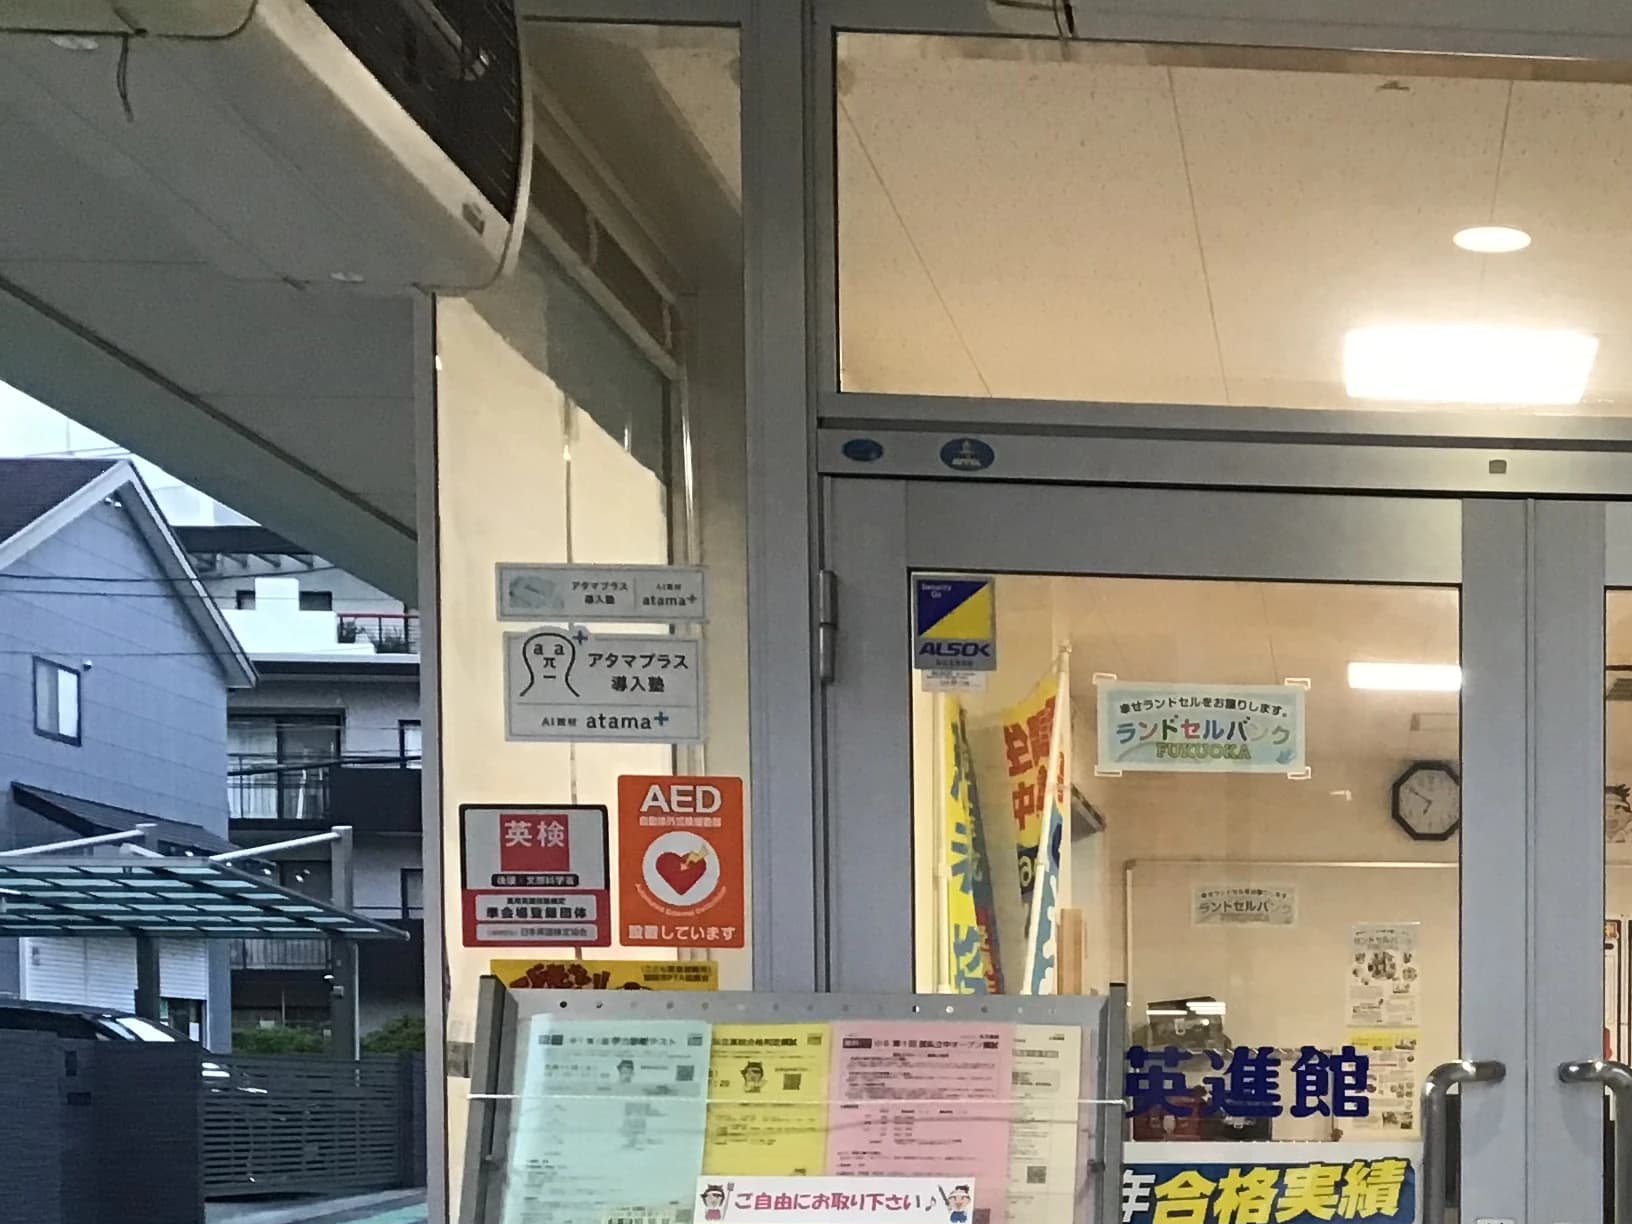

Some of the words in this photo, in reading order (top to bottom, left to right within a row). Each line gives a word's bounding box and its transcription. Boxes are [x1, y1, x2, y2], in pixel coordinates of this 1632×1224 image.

[571, 581, 628, 591] アタマプラス
[642, 594, 697, 606] atama+
[919, 642, 991, 657] ALSOK
[588, 652, 689, 669] アタマプラス
[611, 676, 665, 692] 導入塾
[586, 711, 669, 730] atama+
[1116, 714, 1290, 745] ランドセルバンク
[1156, 742, 1251, 759] FUKUOKA
[640, 784, 722, 813] AED
[504, 820, 565, 848] 英検
[1126, 1045, 1369, 1118] 英進館
